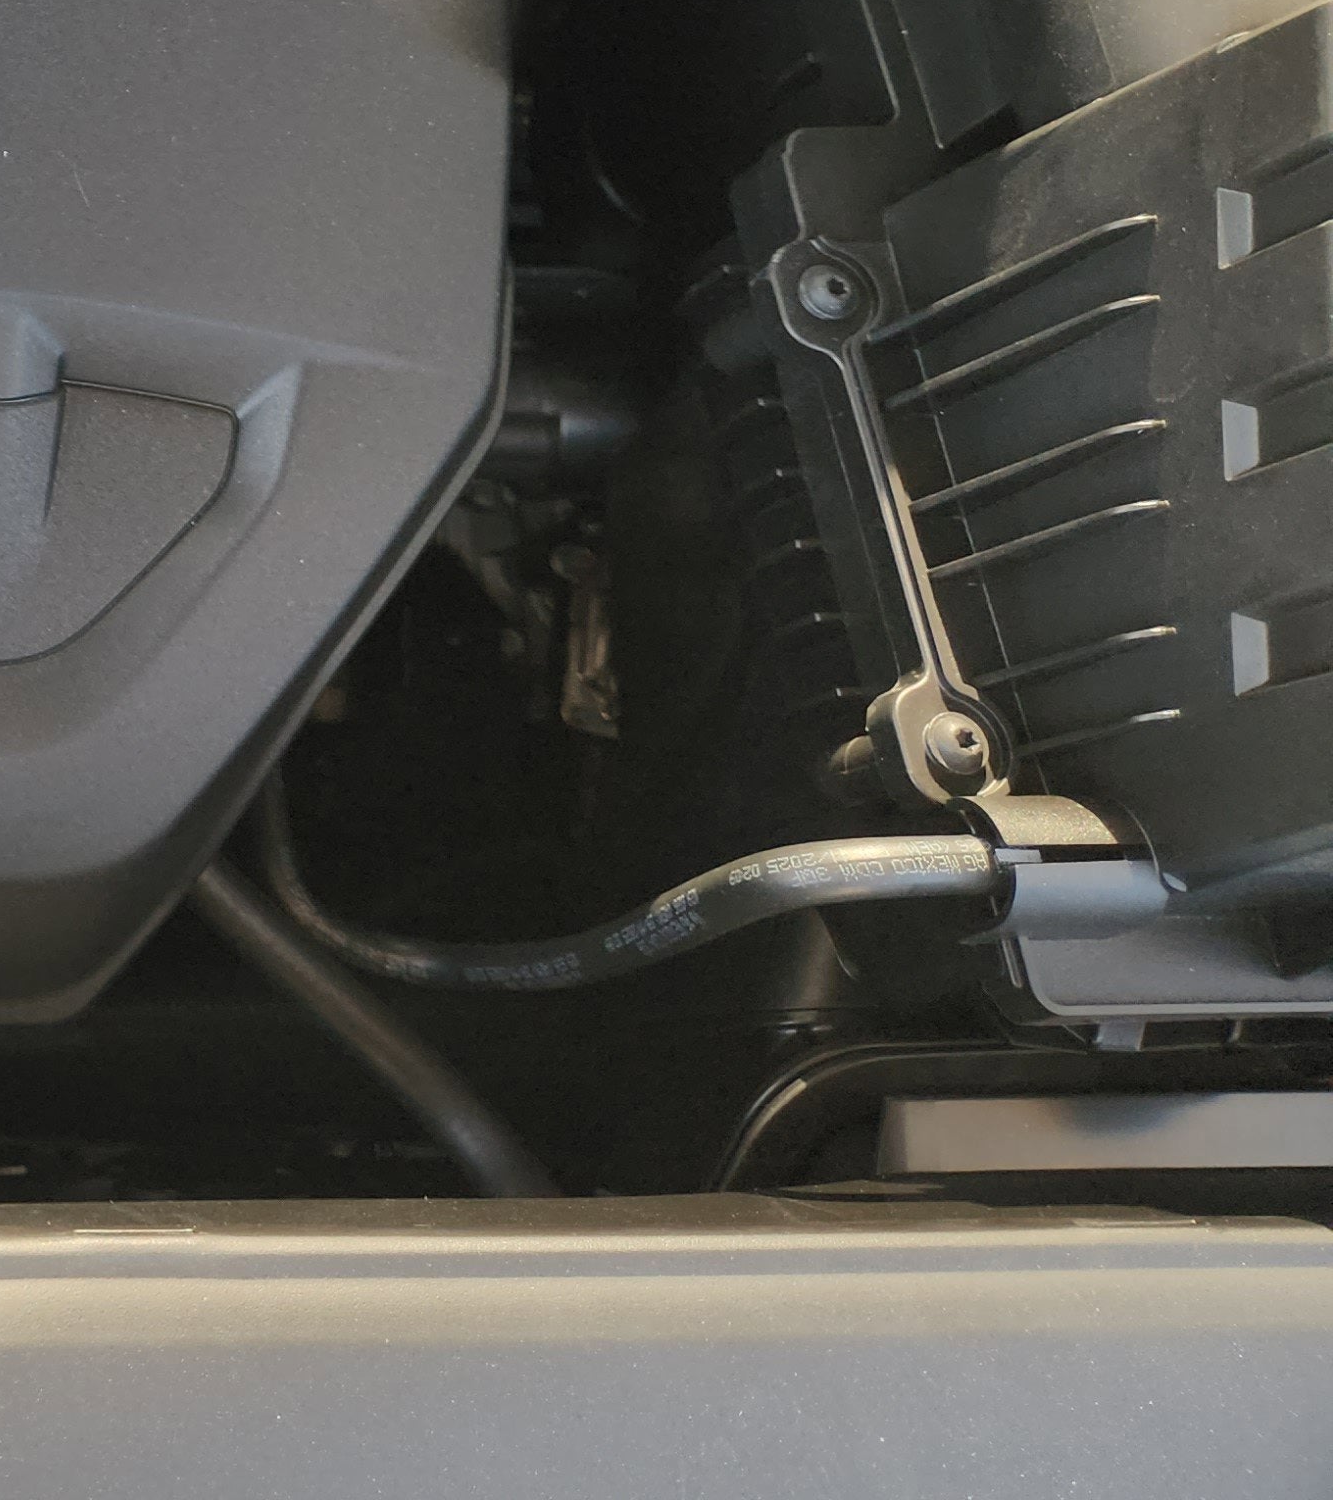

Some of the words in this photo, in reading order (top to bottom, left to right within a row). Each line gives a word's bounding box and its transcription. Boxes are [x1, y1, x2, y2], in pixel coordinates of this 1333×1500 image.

[839, 861, 887, 882] CDM
[889, 852, 963, 877] MEXICO
[964, 854, 989, 873] AG
